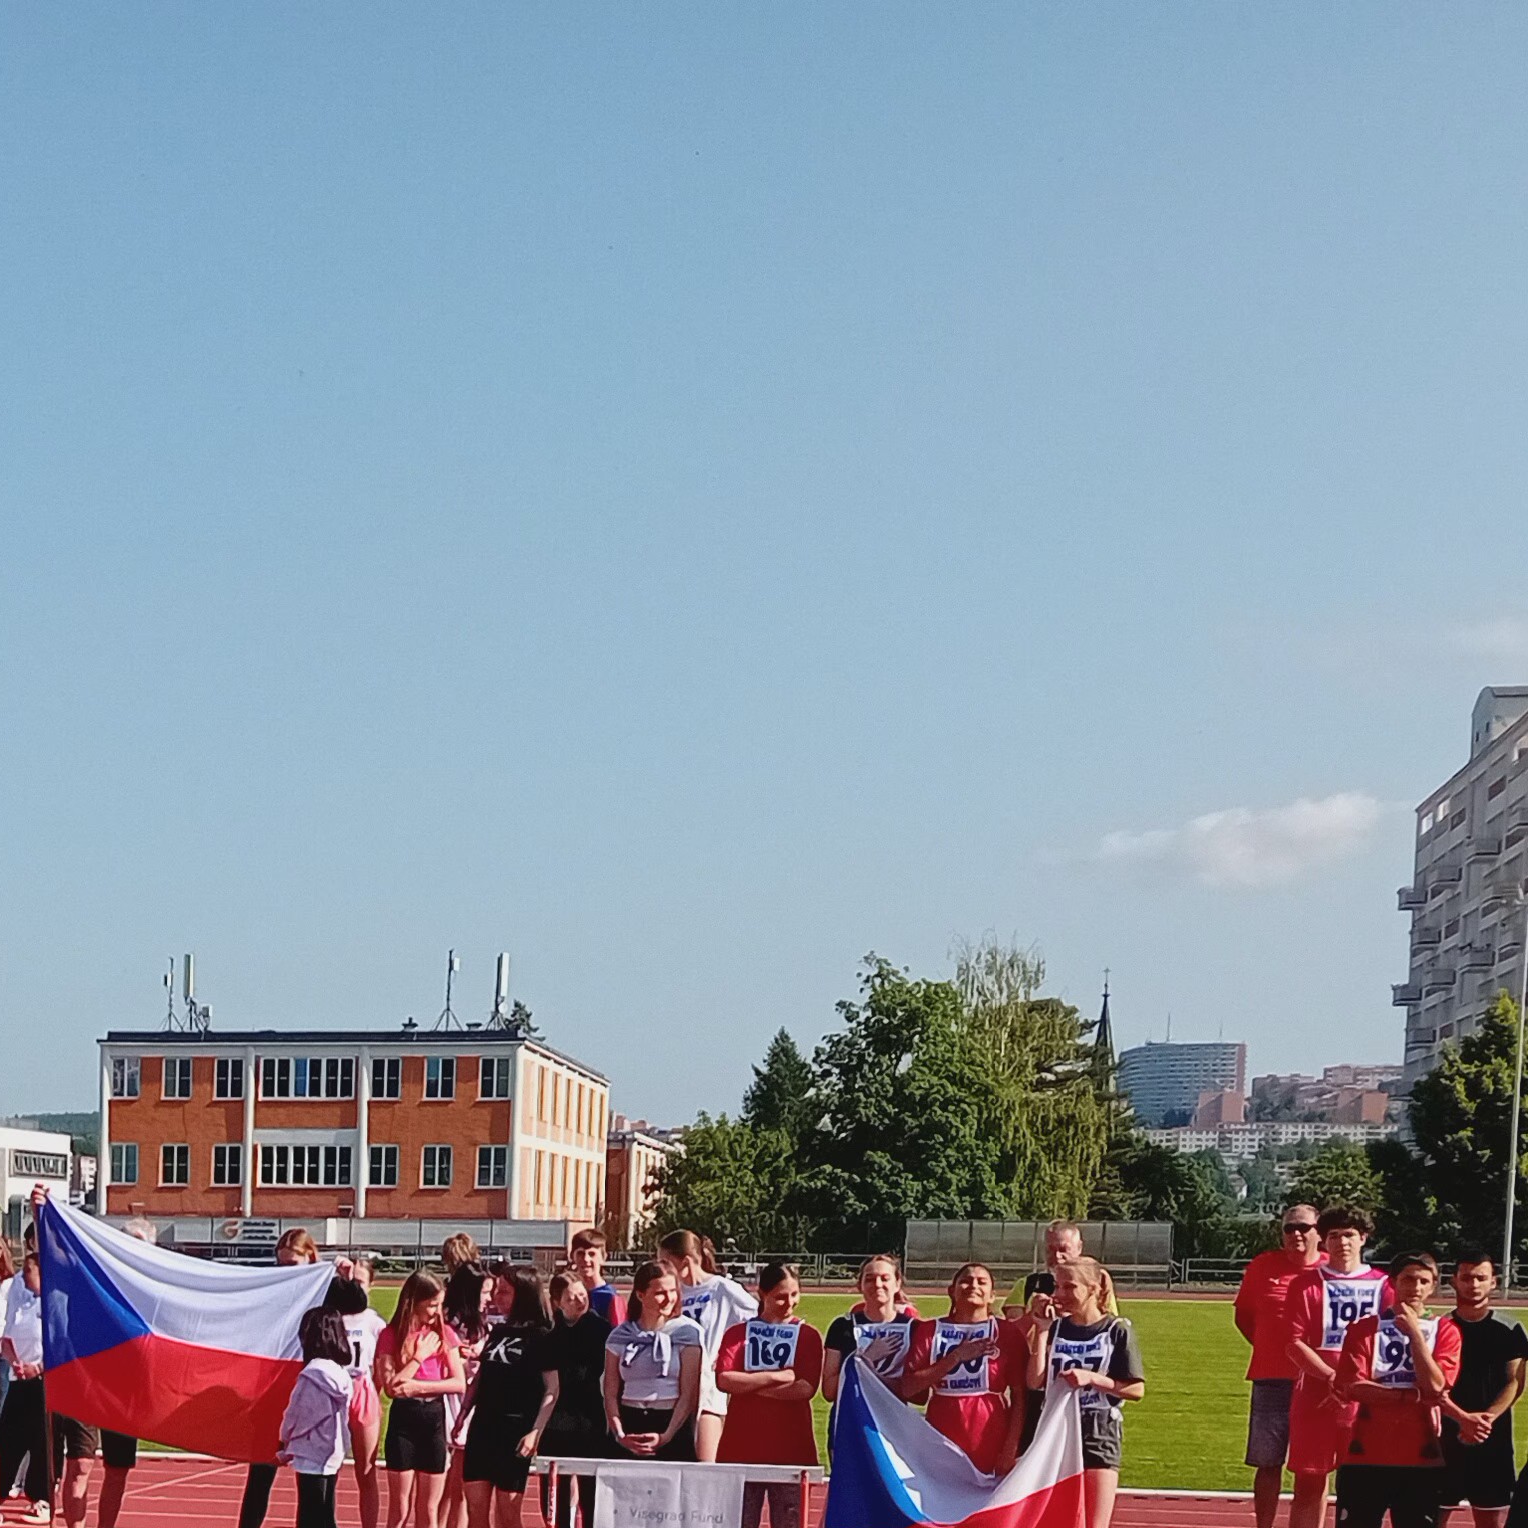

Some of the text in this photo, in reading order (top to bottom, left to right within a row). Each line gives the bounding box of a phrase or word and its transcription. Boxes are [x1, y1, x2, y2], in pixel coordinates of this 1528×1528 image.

[749, 1337, 791, 1369] 169
[630, 1508, 724, 1524] Visegrad Fund
